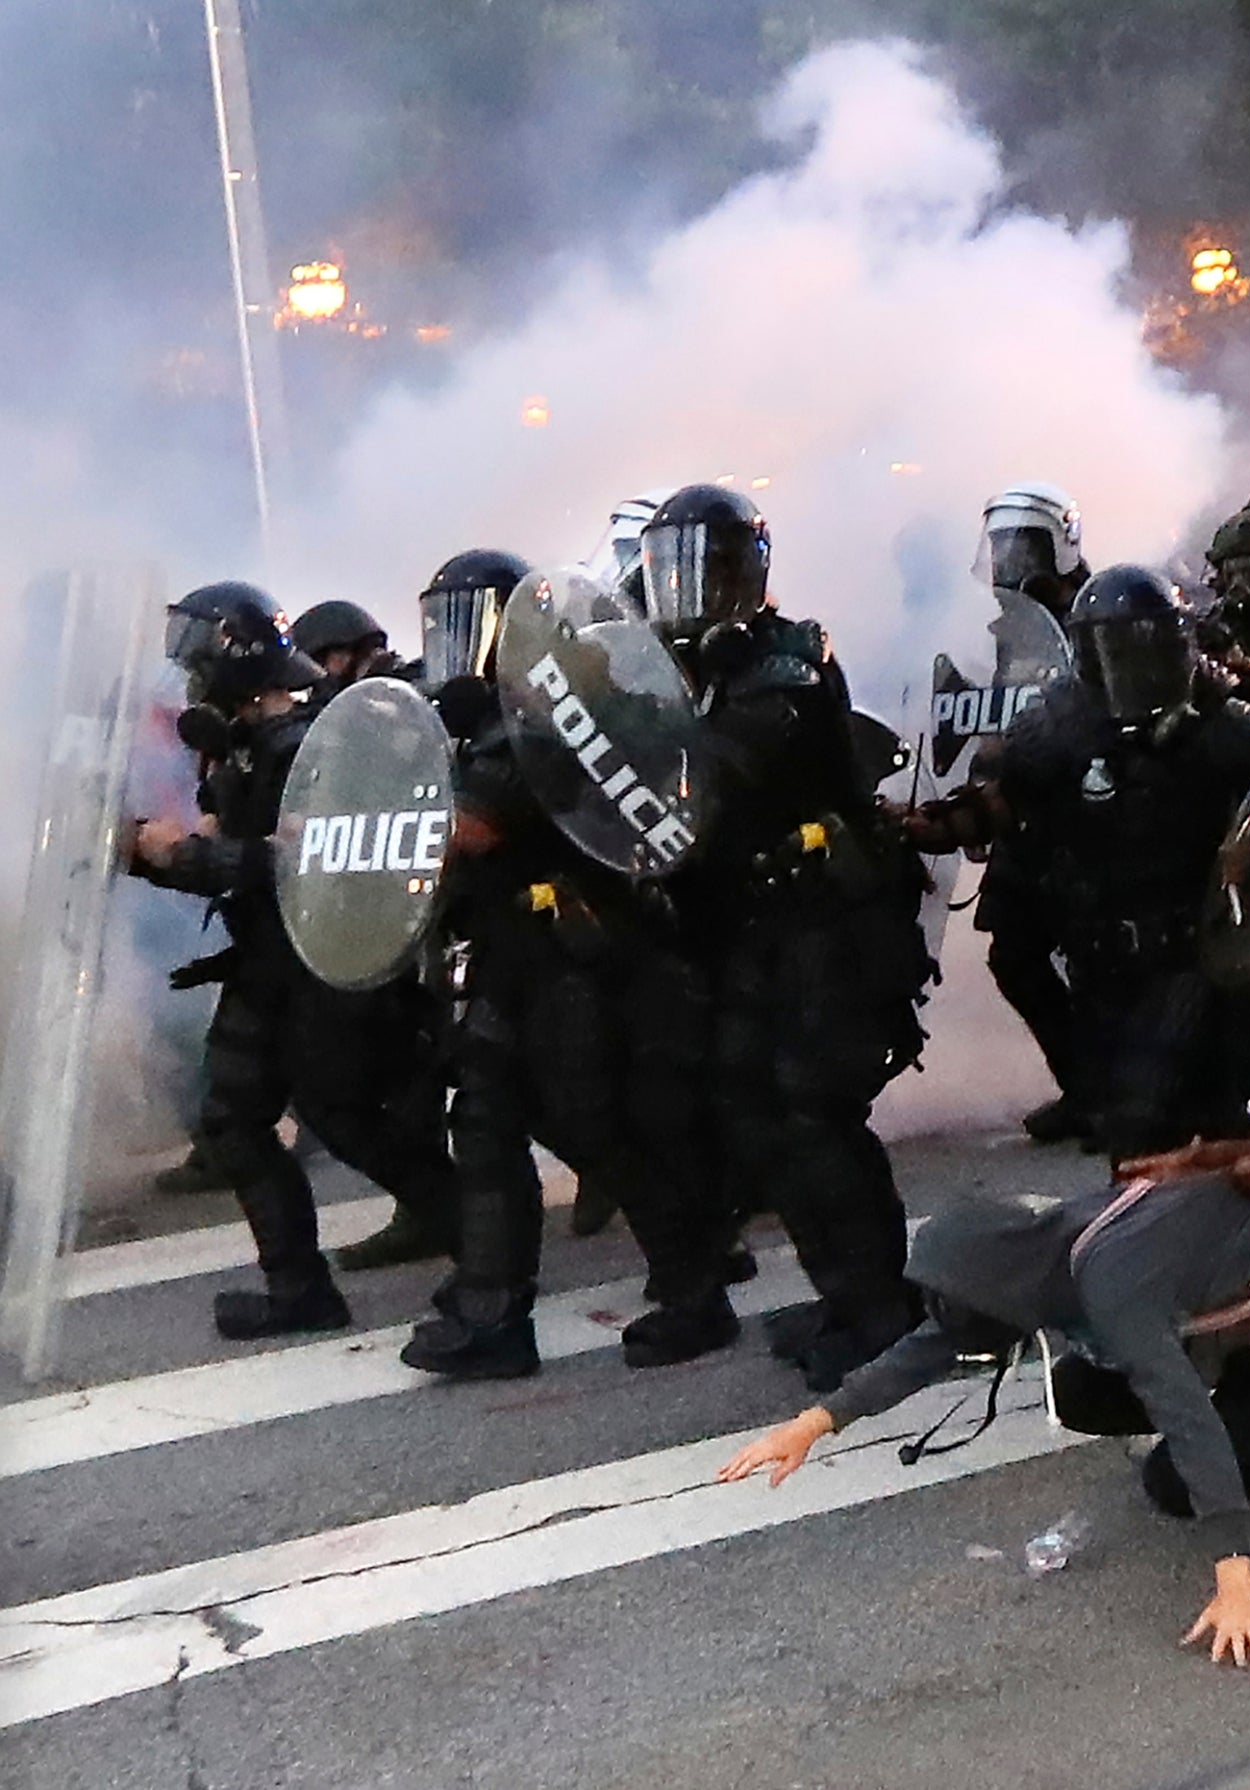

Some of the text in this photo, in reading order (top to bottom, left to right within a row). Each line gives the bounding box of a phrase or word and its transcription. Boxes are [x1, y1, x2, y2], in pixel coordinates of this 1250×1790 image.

[932, 685, 1042, 737] POLIC
[527, 653, 697, 863] POLICE
[298, 809, 449, 876] POLICE
